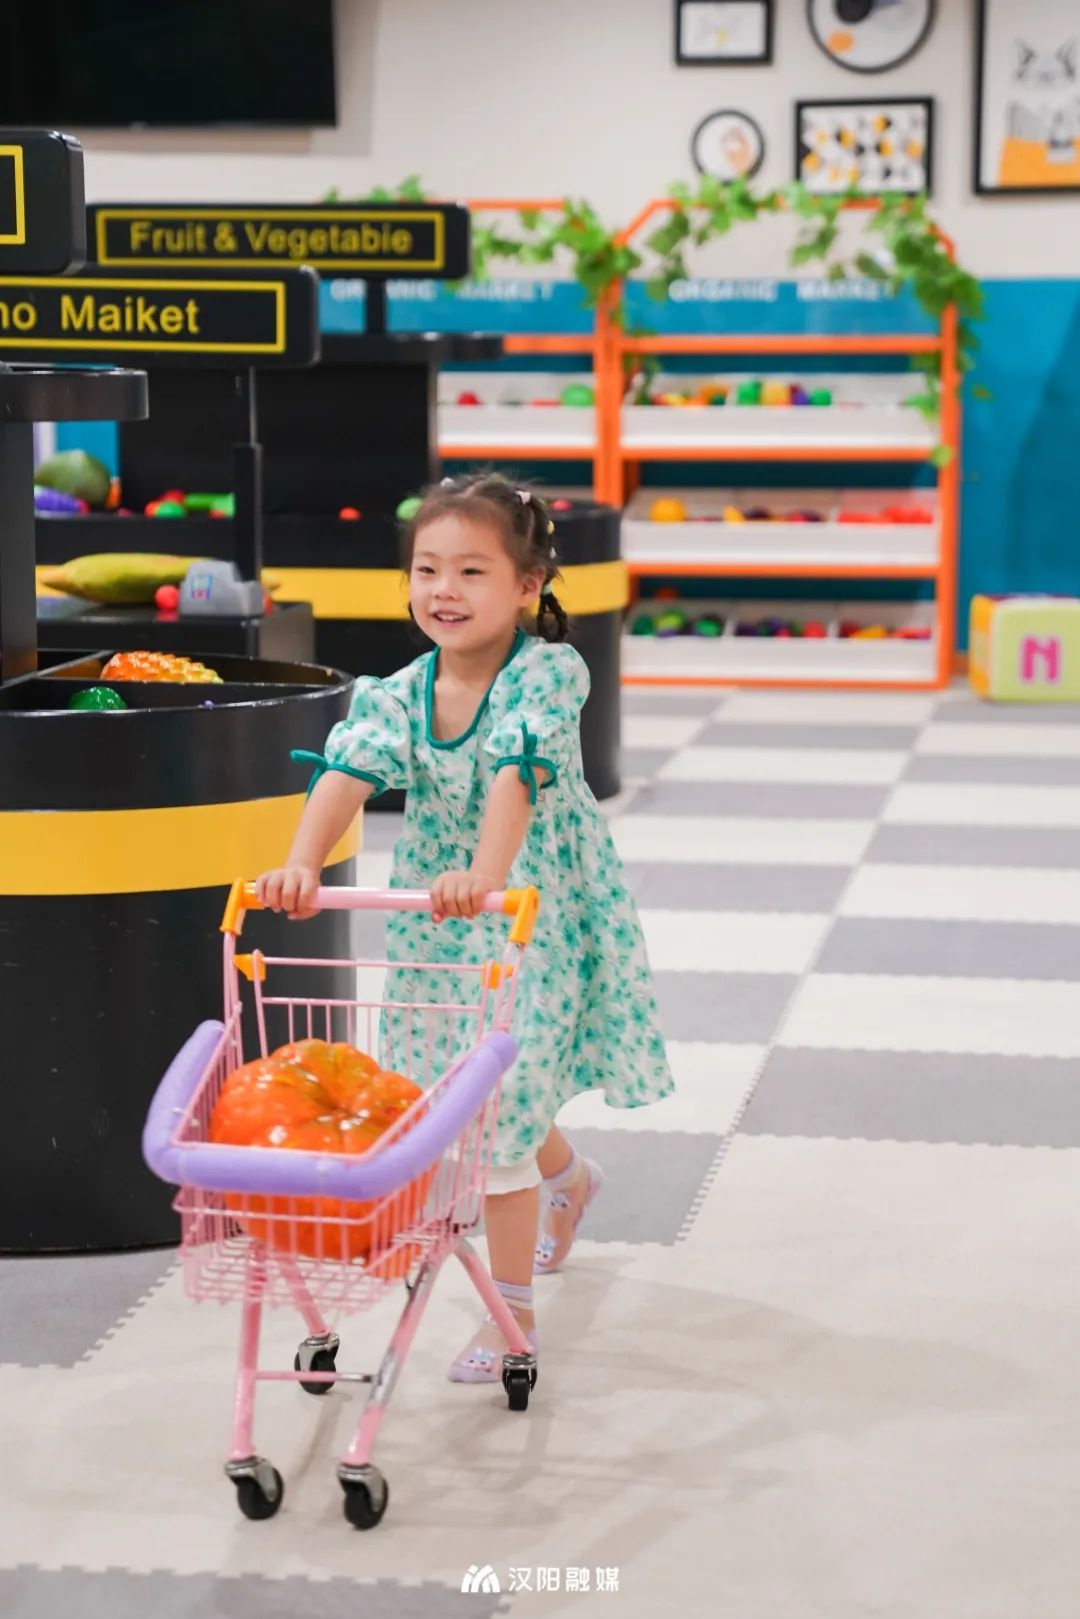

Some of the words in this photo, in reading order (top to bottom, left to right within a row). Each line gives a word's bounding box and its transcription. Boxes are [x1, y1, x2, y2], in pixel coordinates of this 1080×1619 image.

[130, 221, 206, 252] Fruit
[213, 221, 239, 253] &
[60, 294, 200, 334] Maiket
